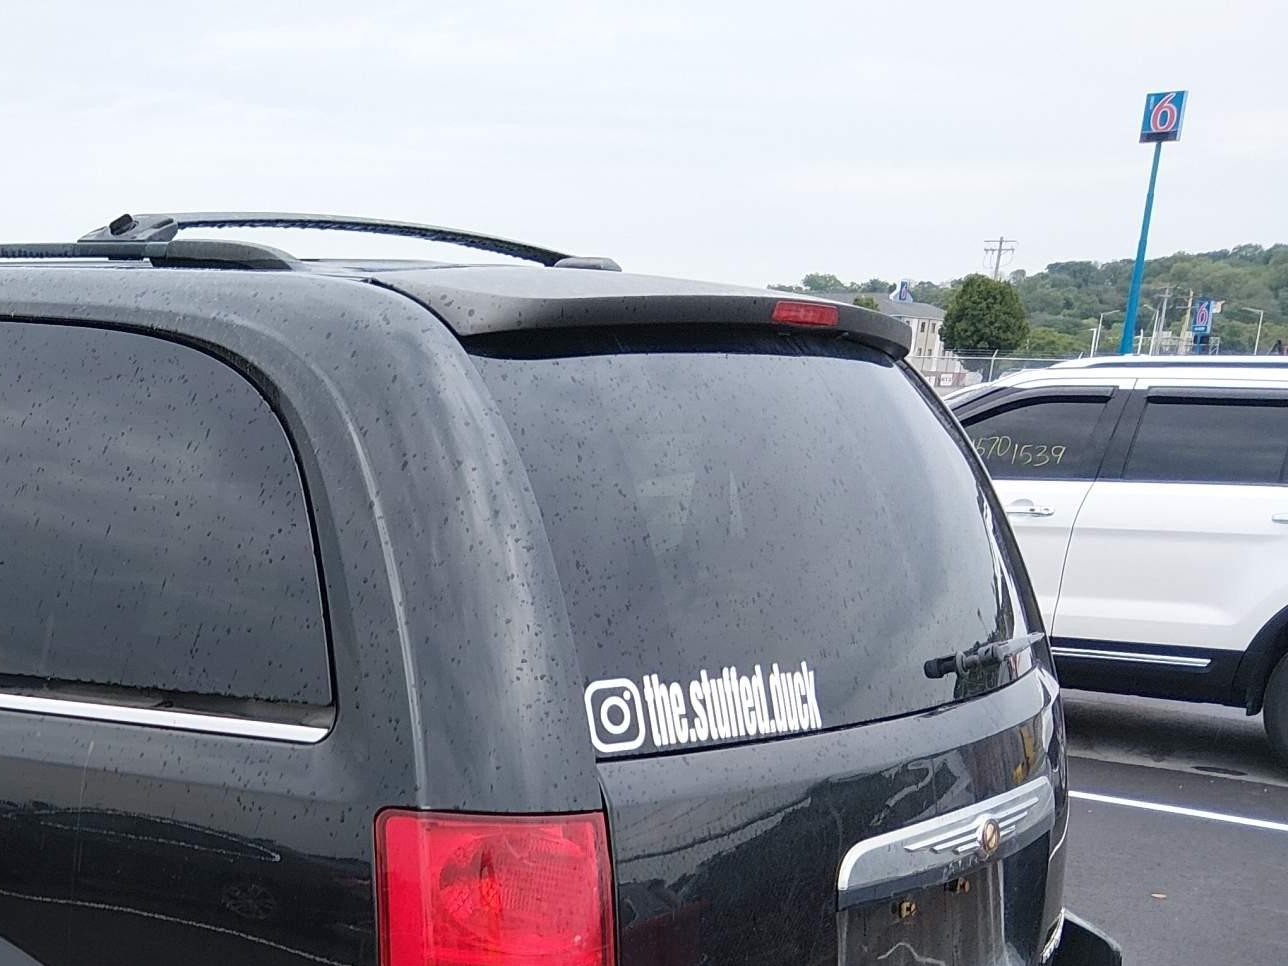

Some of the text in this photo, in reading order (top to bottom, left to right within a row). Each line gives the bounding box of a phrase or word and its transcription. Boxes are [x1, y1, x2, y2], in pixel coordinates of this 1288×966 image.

[1150, 92, 1177, 132] 6
[1196, 300, 1209, 326] 6
[643, 661, 823, 747] the.stuffed.duck
